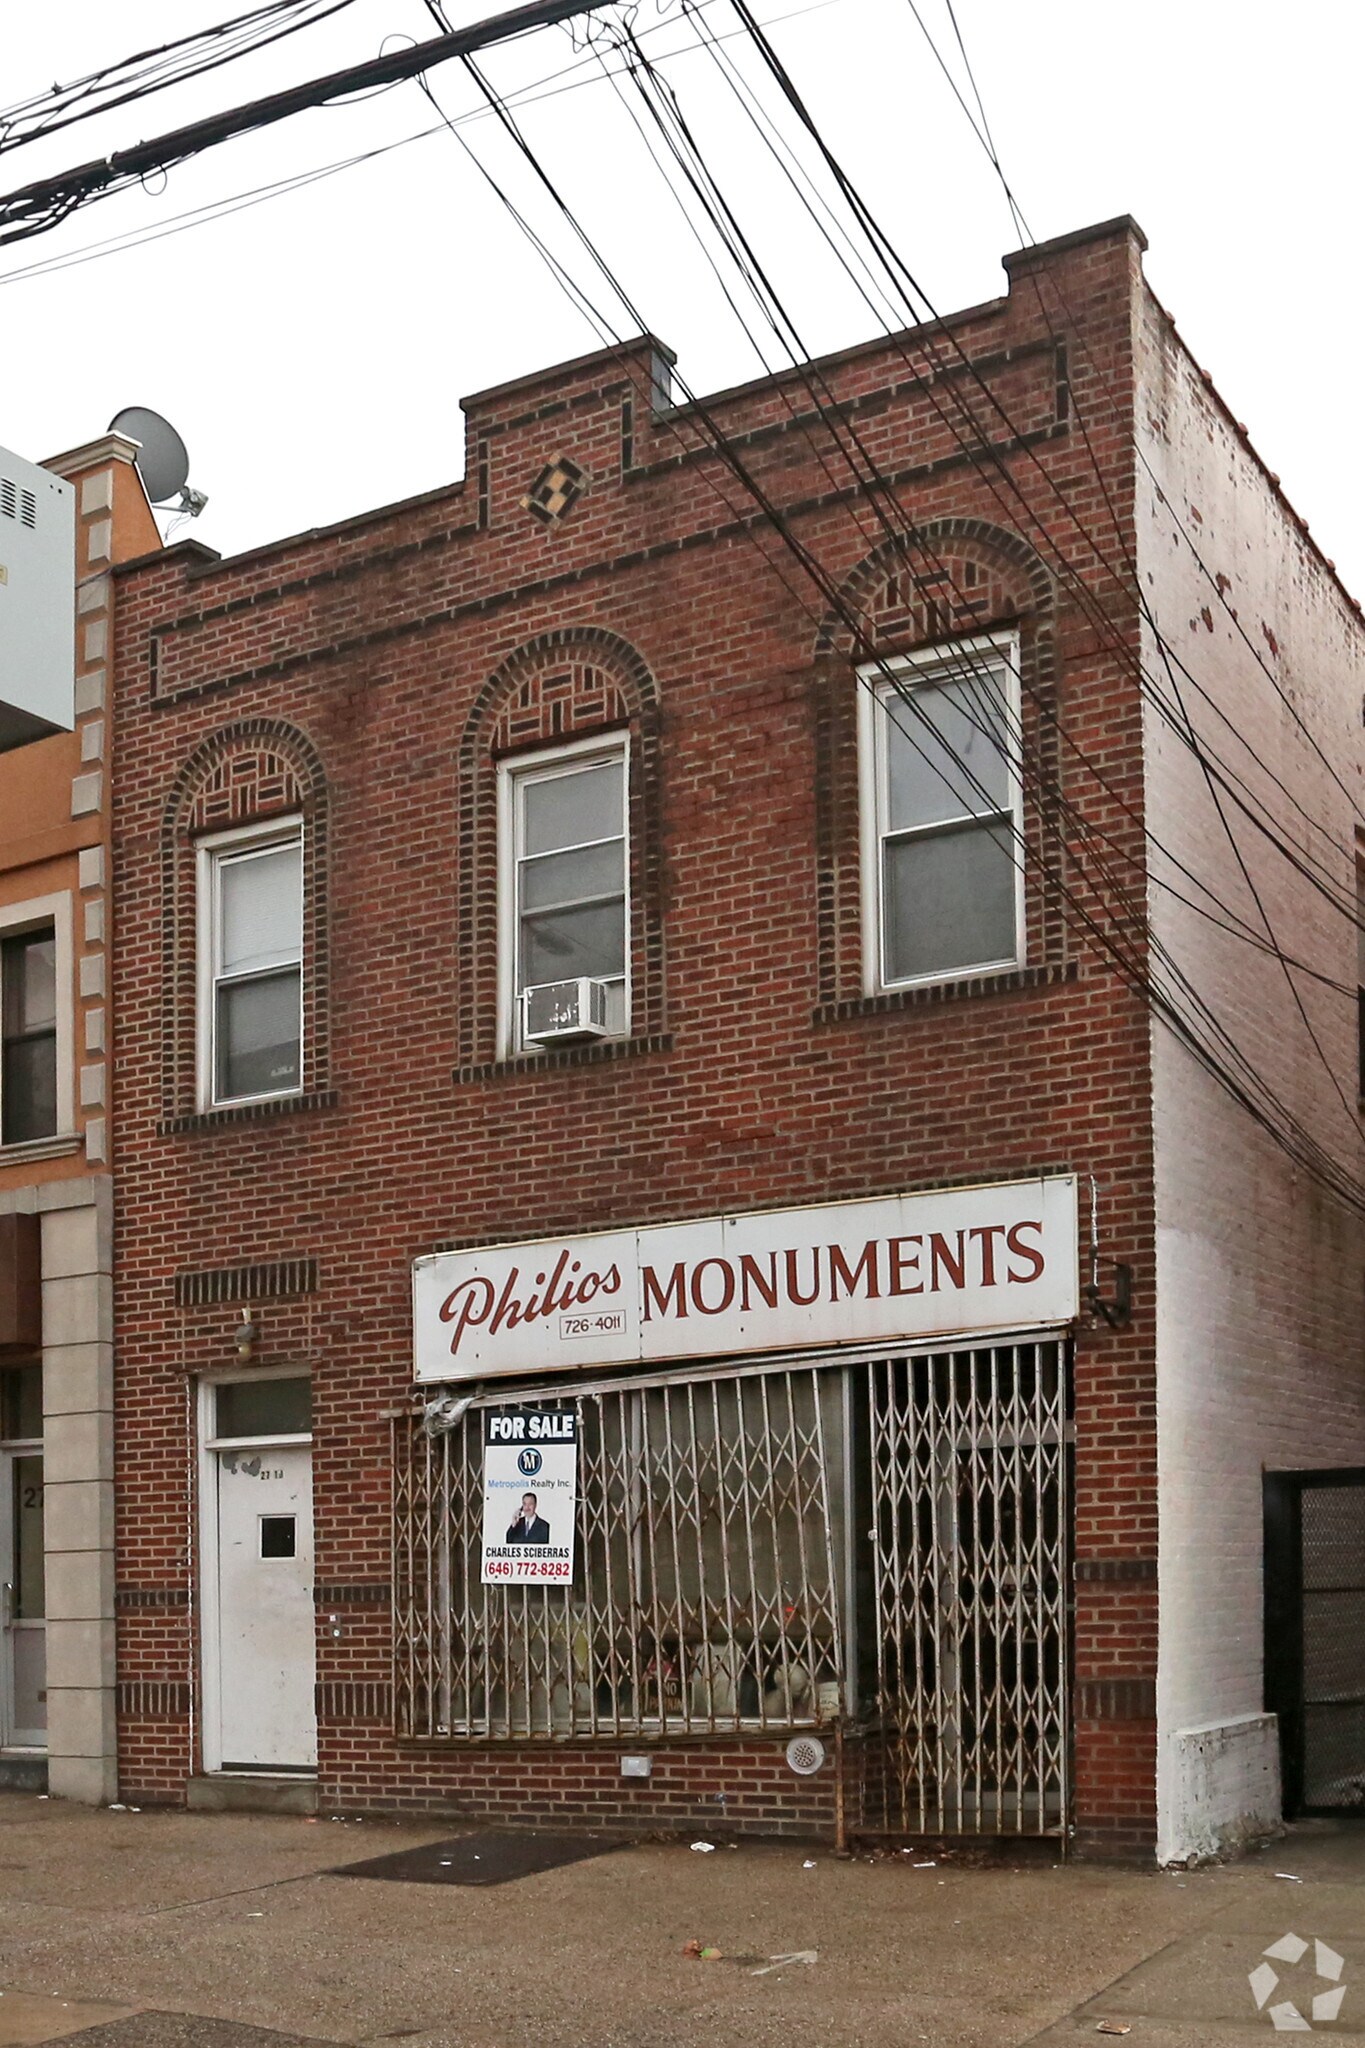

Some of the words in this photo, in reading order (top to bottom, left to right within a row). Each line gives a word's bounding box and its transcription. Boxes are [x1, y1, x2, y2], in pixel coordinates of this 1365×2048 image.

[439, 1249, 621, 1355] Philios
[641, 1221, 1045, 1322] MONUMENTS
[490, 1416, 525, 1439] FOR
[528, 1415, 574, 1439] SALE
[488, 1479, 529, 1489] Metropolis
[531, 1479, 555, 1489] Realty
[557, 1479, 572, 1487] Inc.
[486, 1547, 521, 1558] CHARLES
[523, 1547, 570, 1558] SCIBERRAS
[484, 1562, 513, 1577] (646)
[517, 1562, 570, 1576] 772-8282
